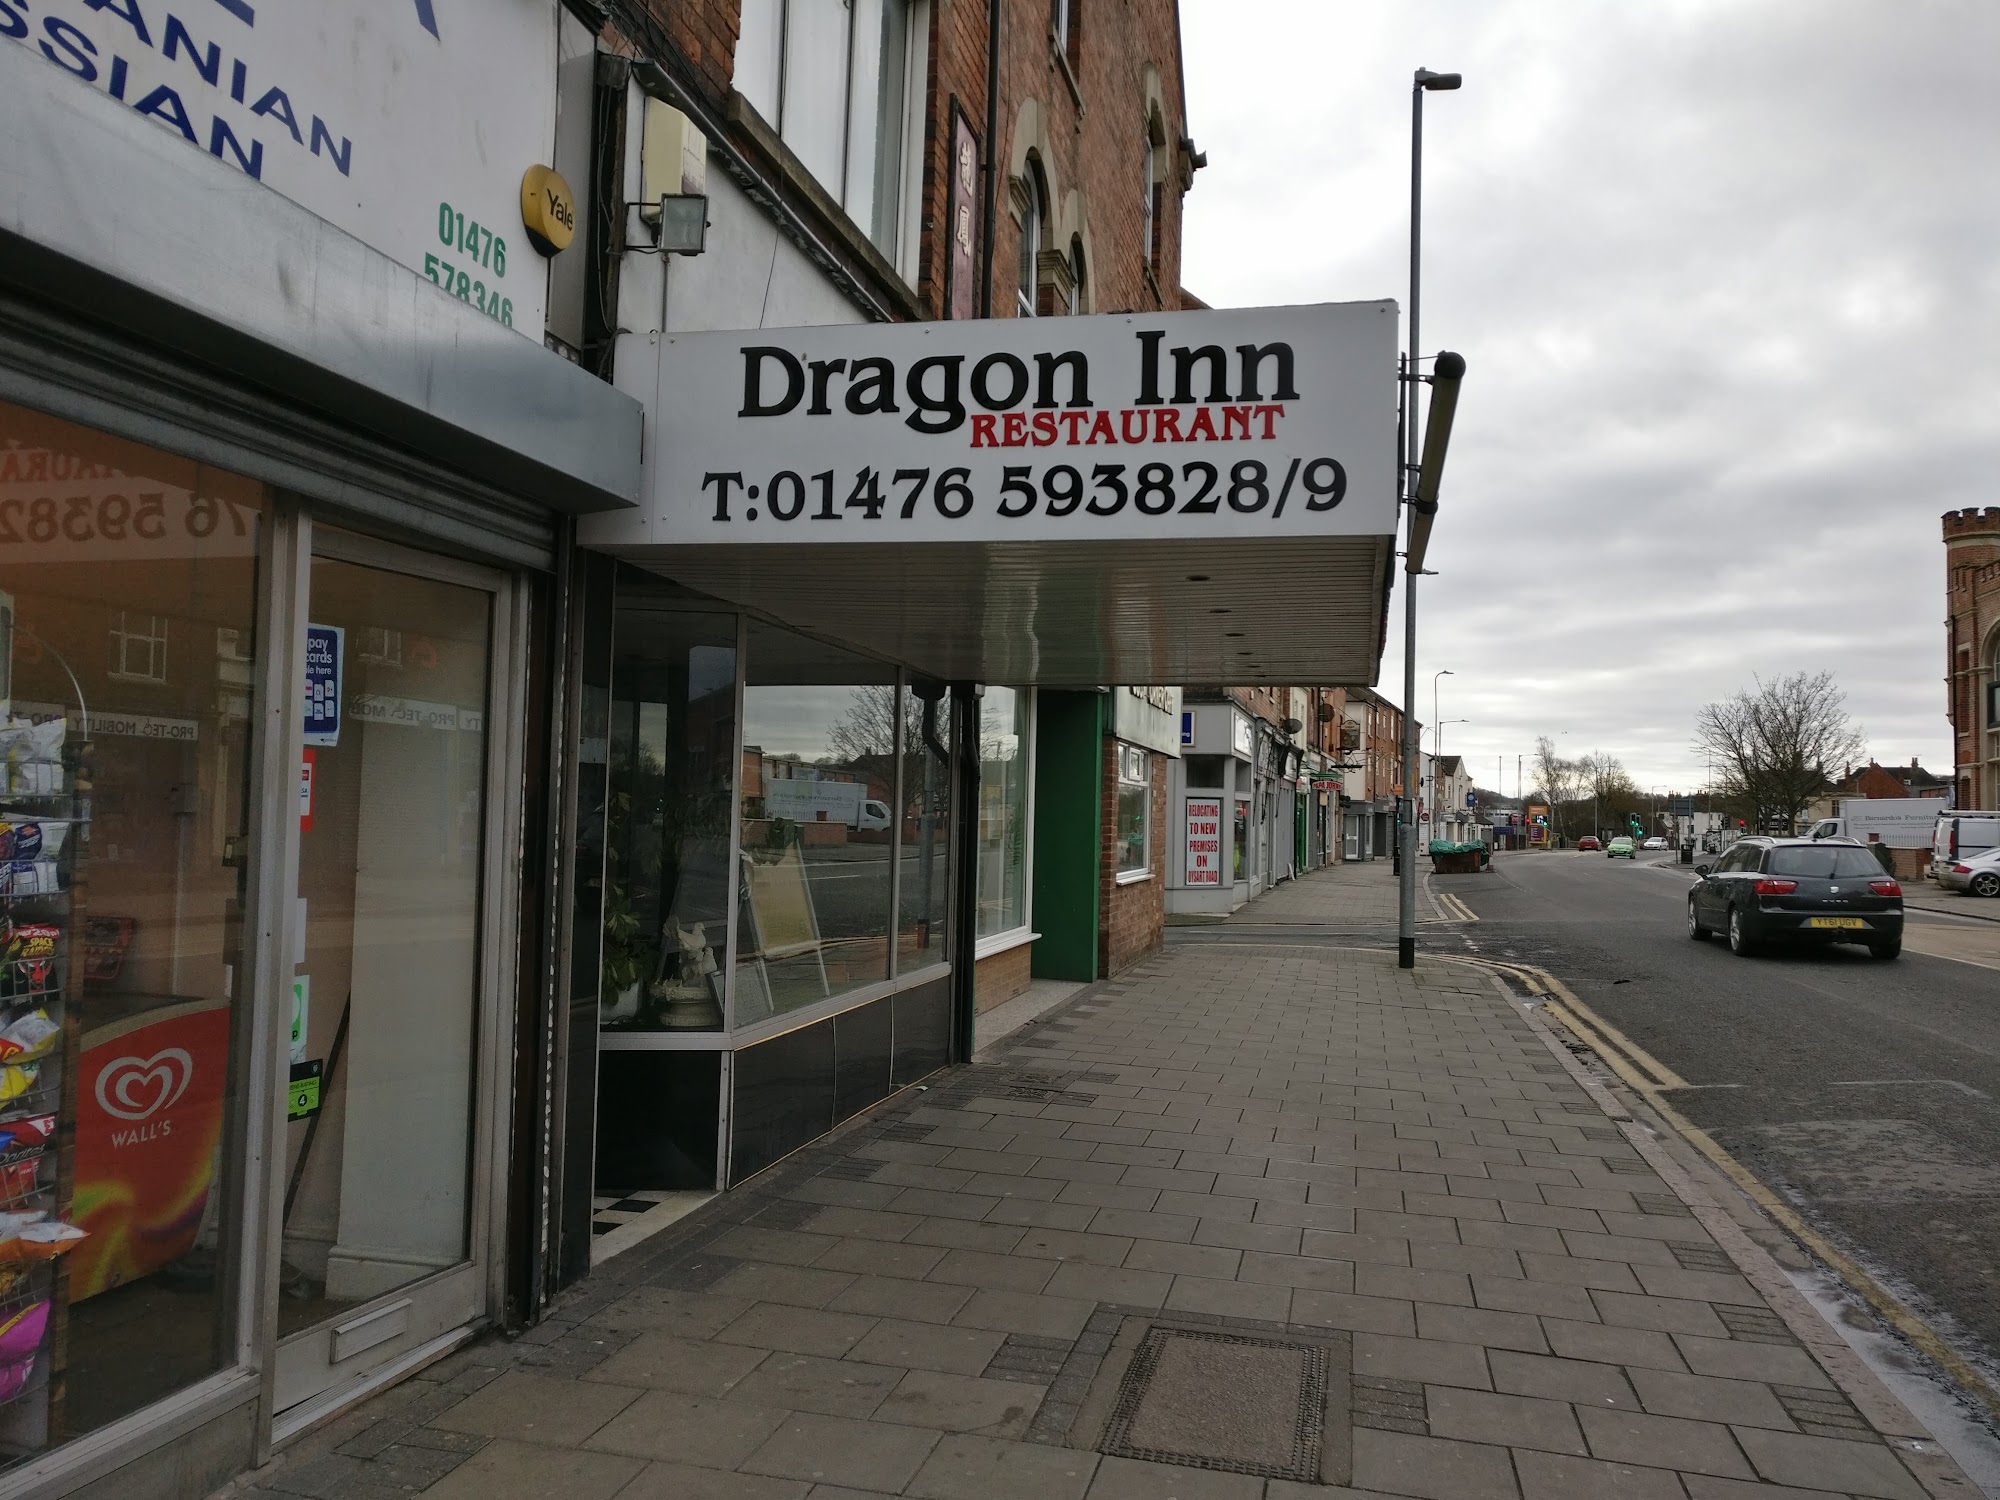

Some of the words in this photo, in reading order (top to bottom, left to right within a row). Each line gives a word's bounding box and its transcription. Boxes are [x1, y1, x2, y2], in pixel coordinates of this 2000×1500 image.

[546, 188, 573, 232] Yale
[438, 202, 506, 278] 01476
[424, 252, 513, 328] 578346
[737, 346, 1094, 435] Dragon
[1134, 330, 1300, 406] Inn
[970, 403, 1286, 449] RESTAURANT
[702, 465, 974, 522] T:01476
[996, 457, 1348, 518] 593828/9
[316, 665, 332, 675] here
[1188, 804, 1219, 817] RELOCATING
[1189, 822, 1199, 835] TO
[1200, 822, 1217, 835] NEW
[1189, 840, 1218, 853] PREMISES
[1196, 855, 1208, 867] ON
[299, 1095, 306, 1106] 4
[111, 1118, 172, 1149] WALL'S
